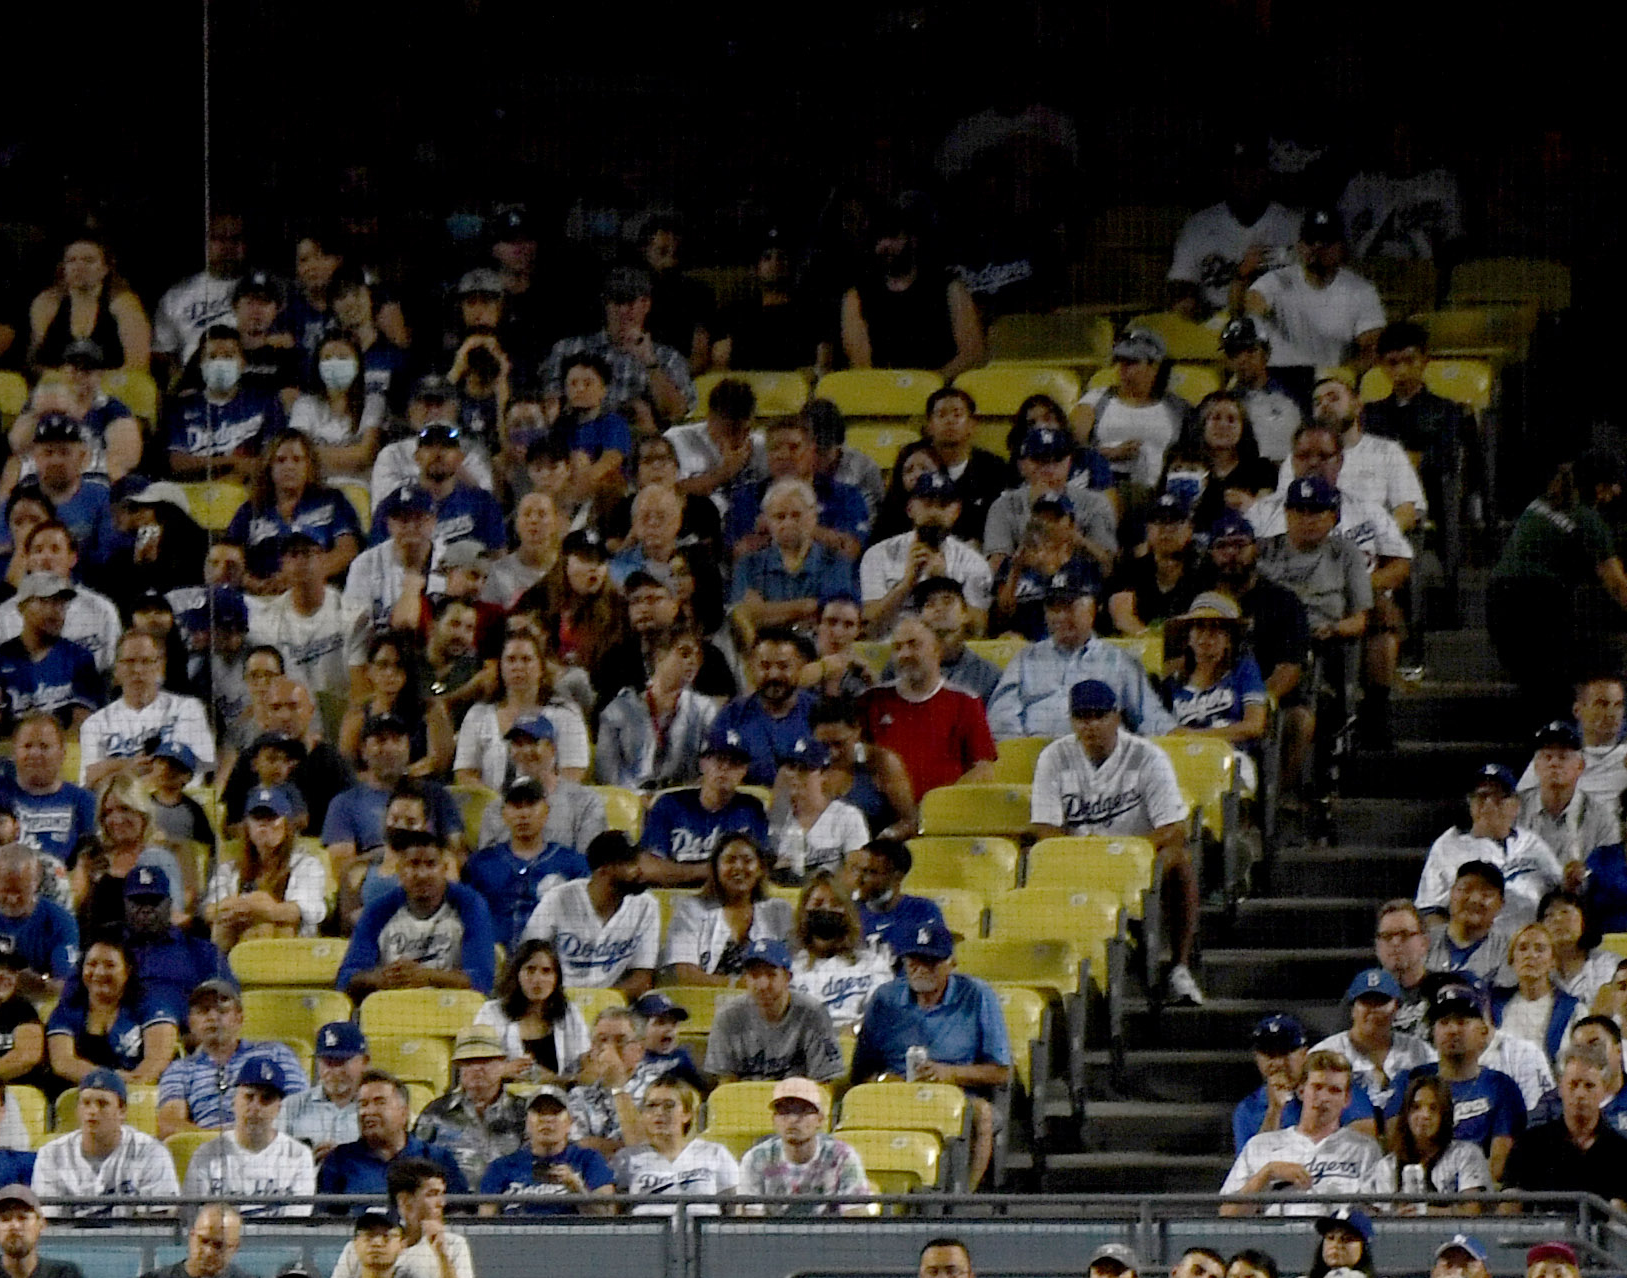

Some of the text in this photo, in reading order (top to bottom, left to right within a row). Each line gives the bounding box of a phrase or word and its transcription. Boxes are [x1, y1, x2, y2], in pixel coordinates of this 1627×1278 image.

[1062, 787, 1143, 828] Dodgers
[555, 932, 645, 972] Dodgers
[1307, 1158, 1362, 1184] dgers
